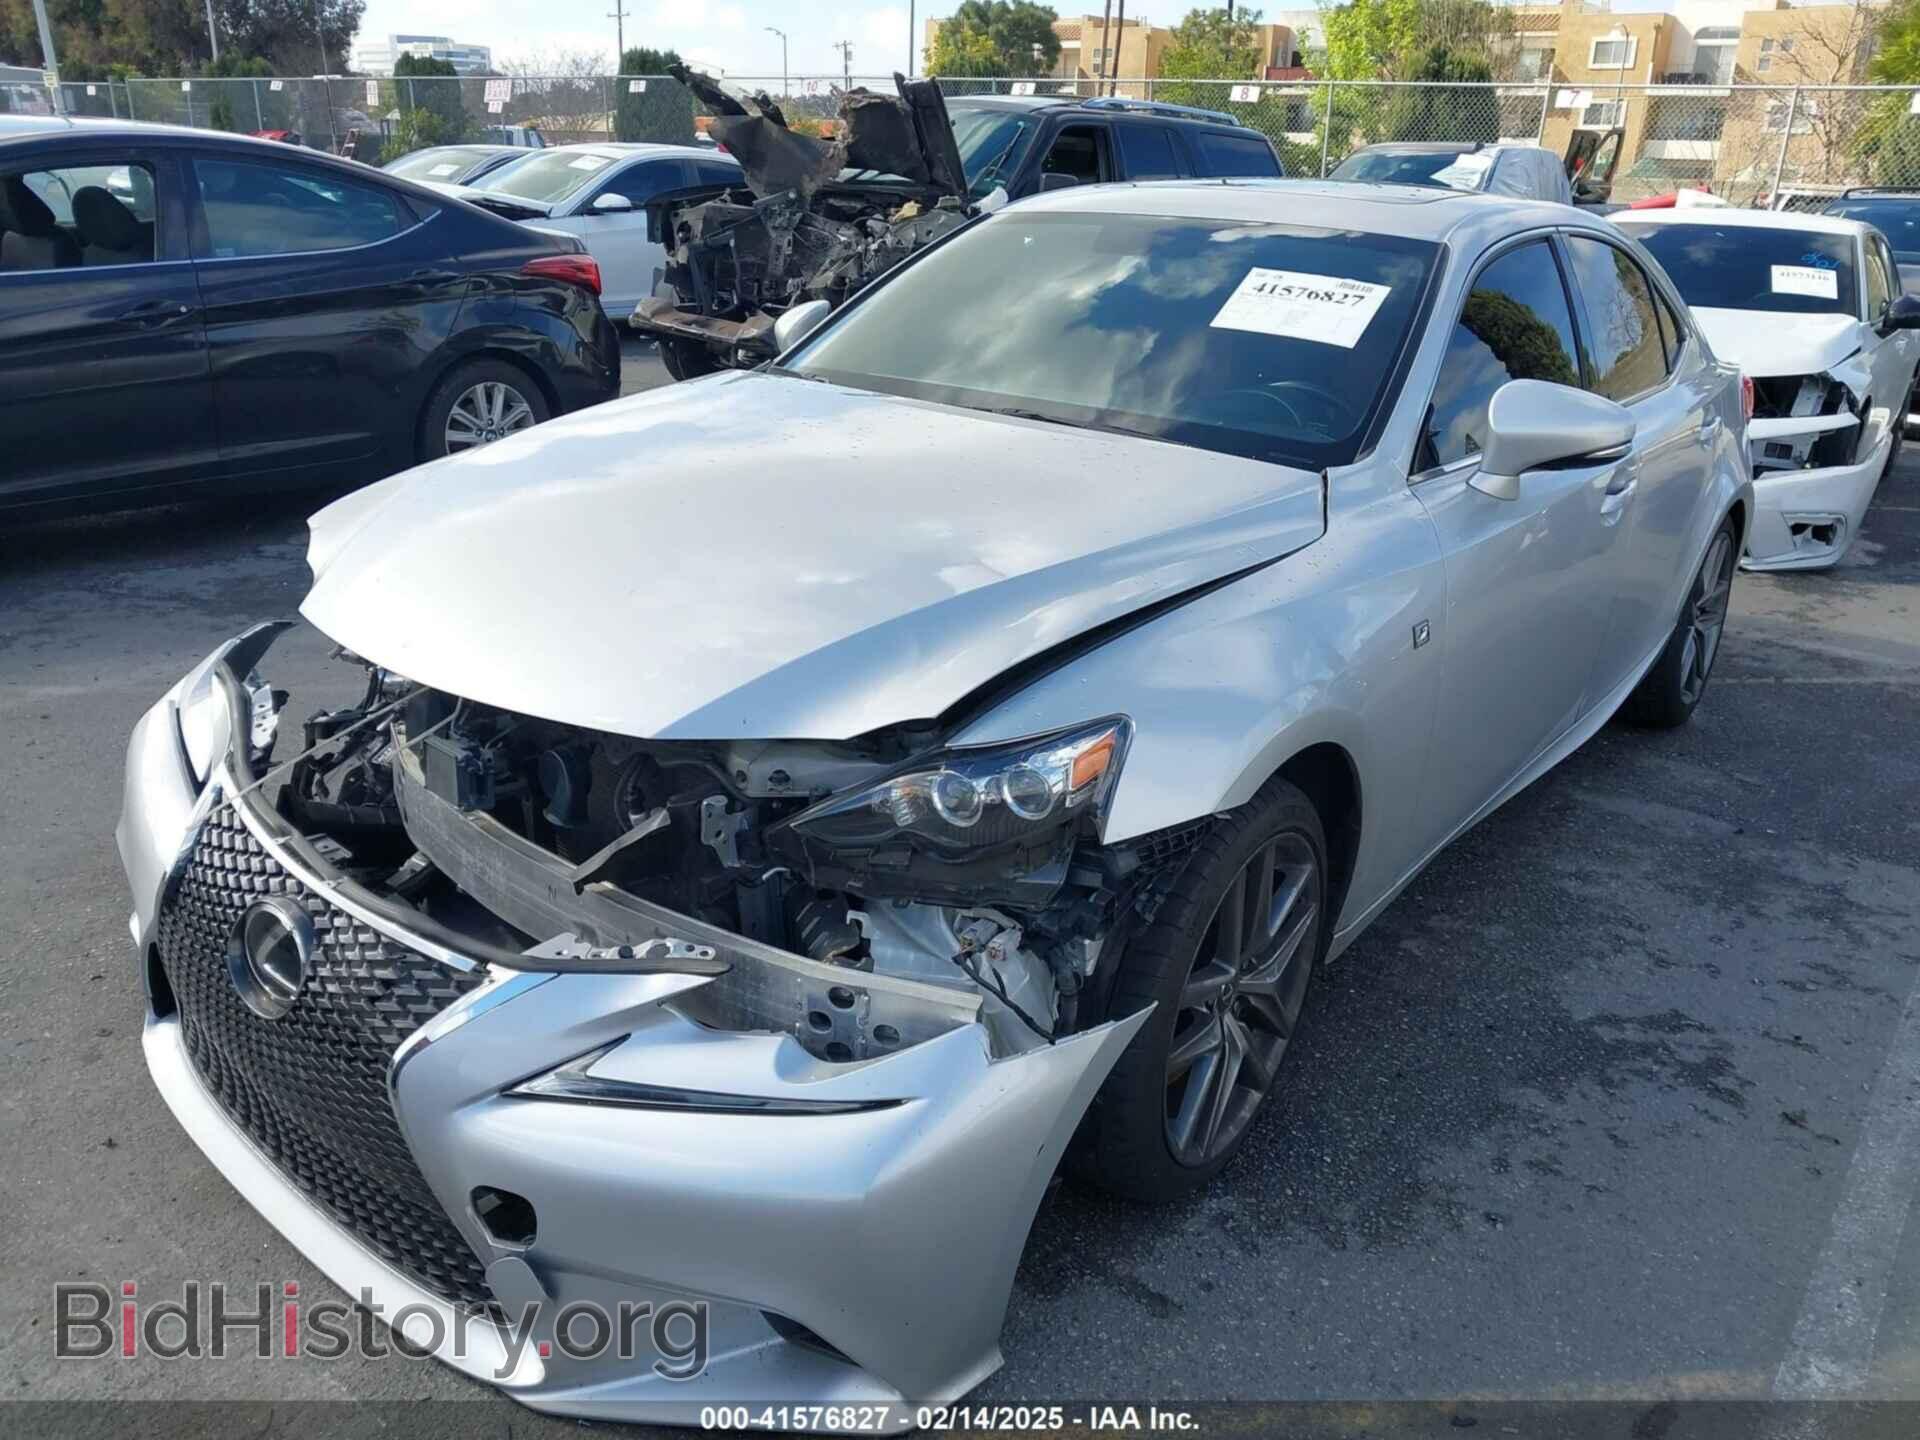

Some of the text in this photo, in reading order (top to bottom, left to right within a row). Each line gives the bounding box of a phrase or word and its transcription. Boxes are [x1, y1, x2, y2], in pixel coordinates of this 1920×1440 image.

[1240, 87, 1249, 100] 8
[1570, 90, 1581, 105] 7
[1253, 281, 1366, 307] 41576827
